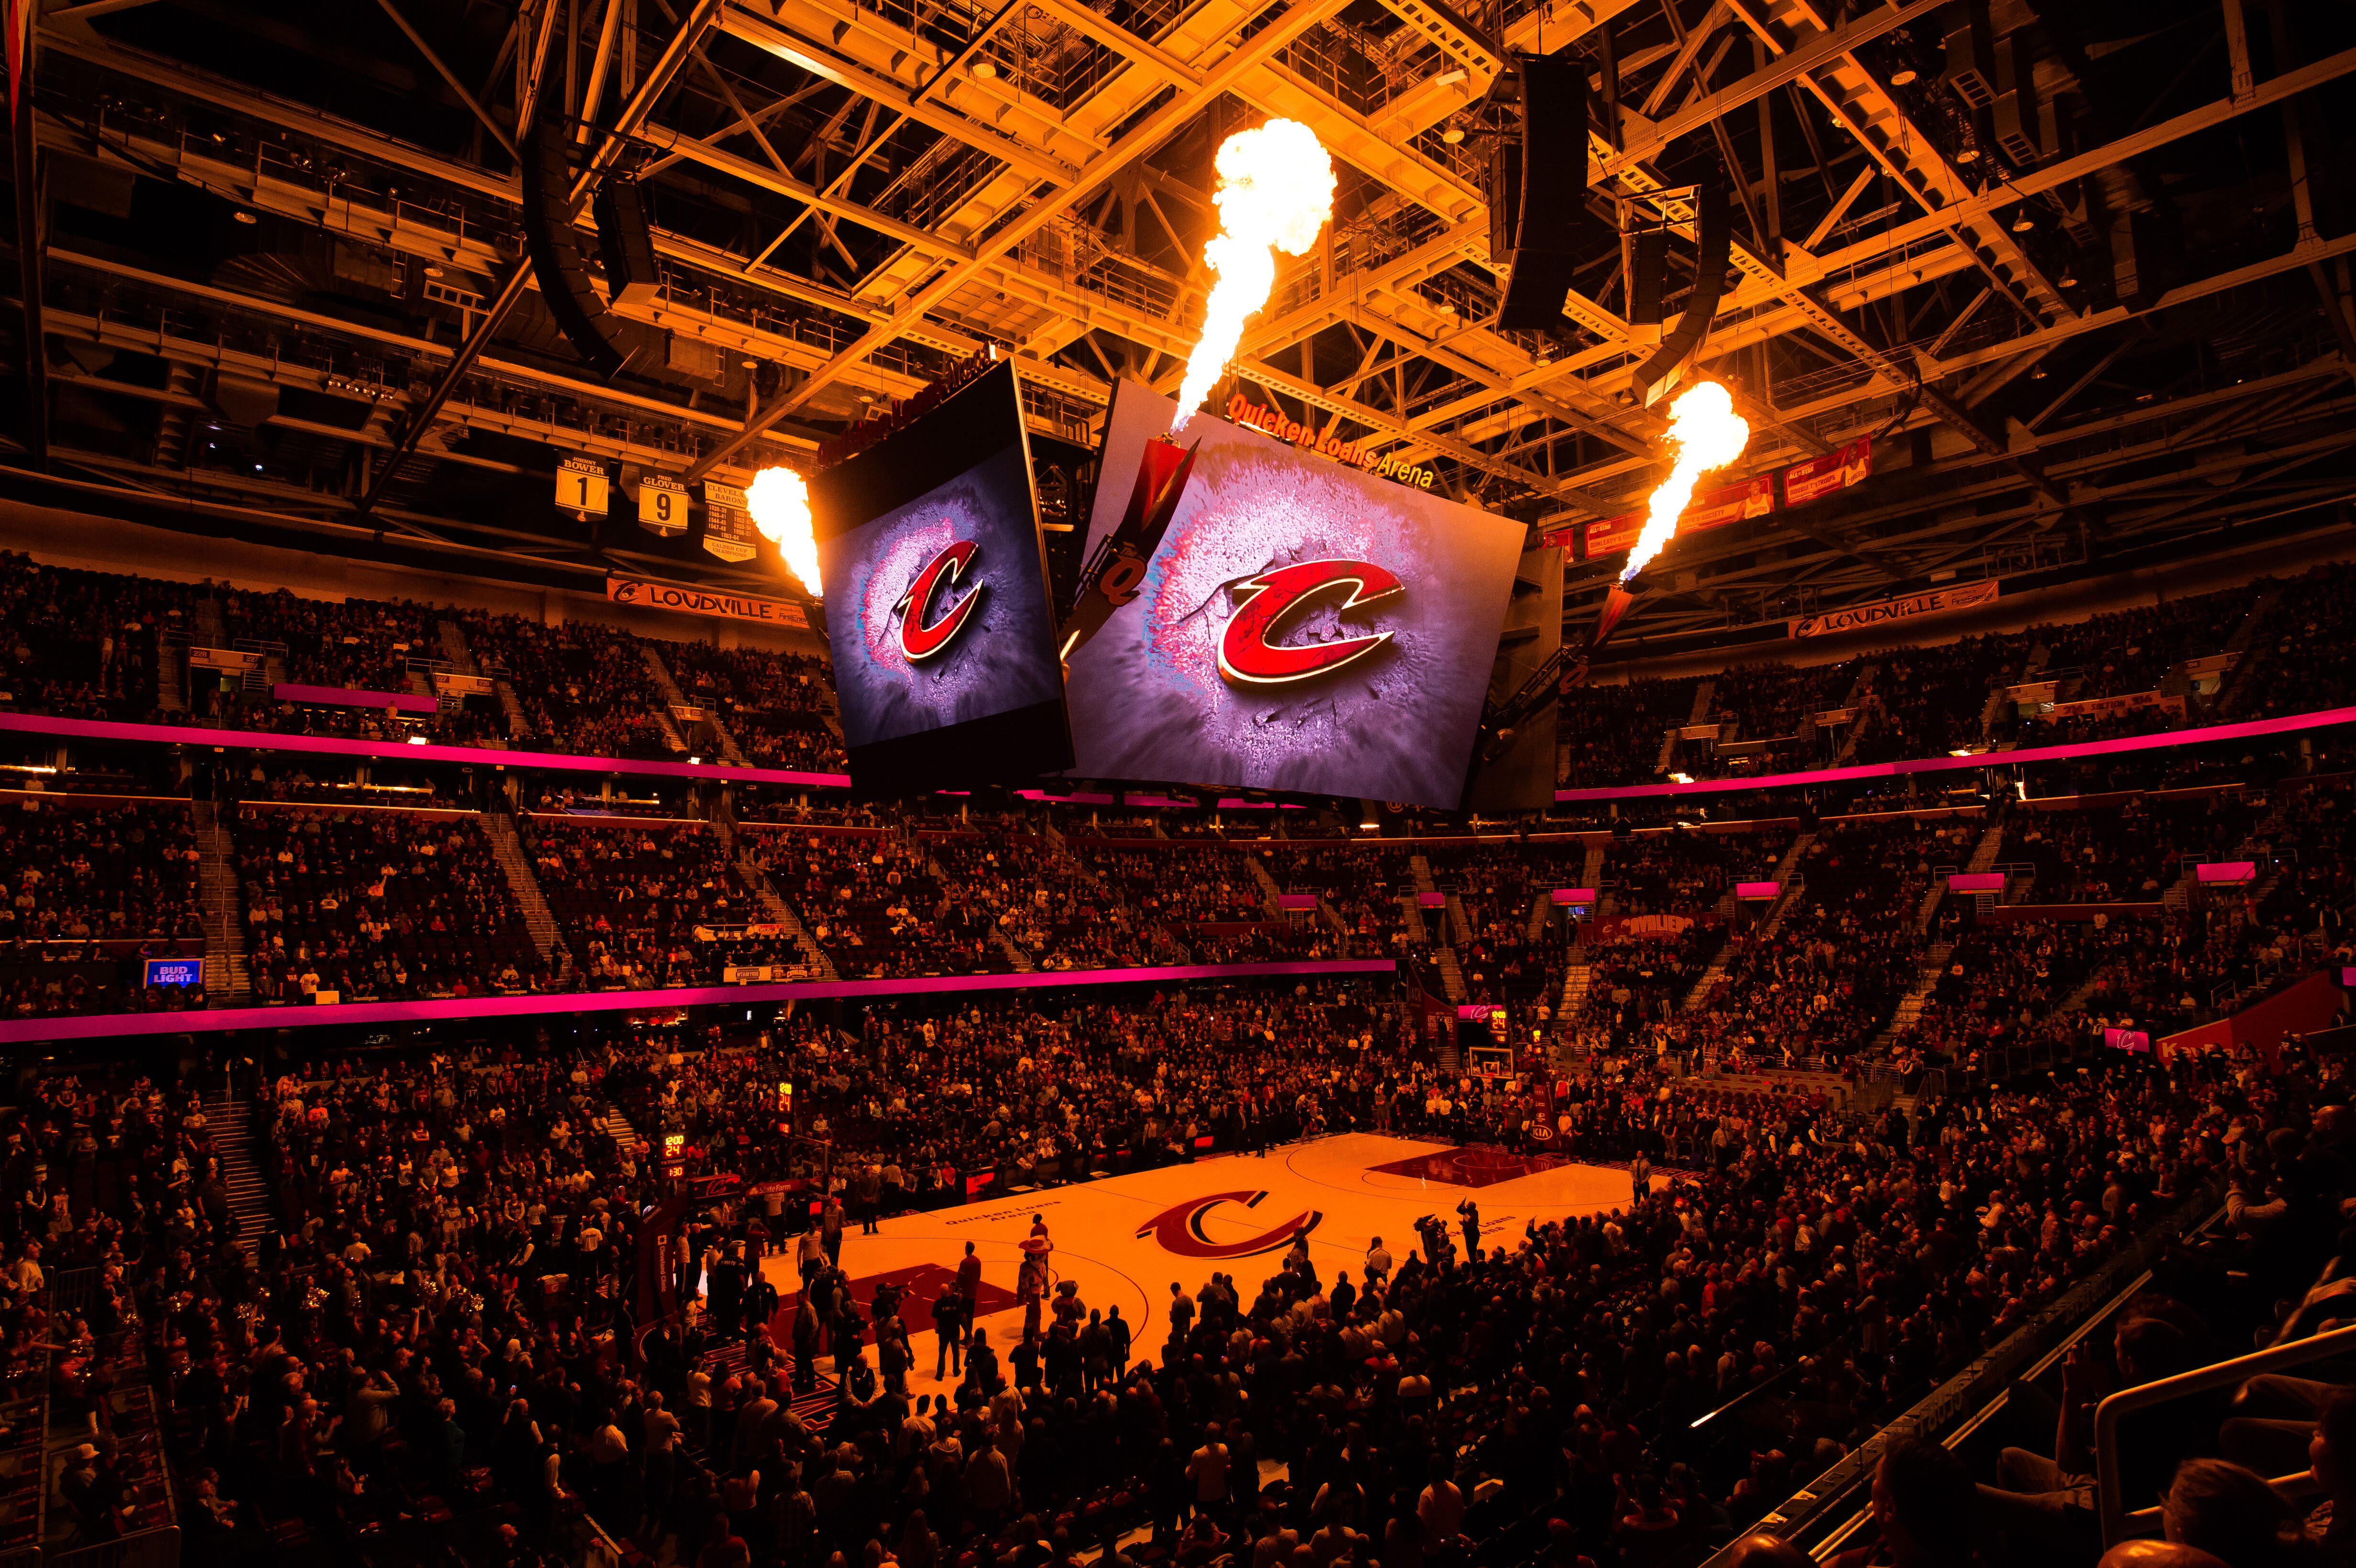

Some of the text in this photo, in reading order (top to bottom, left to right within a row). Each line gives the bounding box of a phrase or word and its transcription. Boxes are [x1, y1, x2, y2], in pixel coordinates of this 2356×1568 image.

[1228, 393, 1433, 488] Quicken Loans Arena
[573, 457, 596, 465] JOHNNY
[564, 459, 604, 475] BOWER
[643, 477, 685, 491] GLOVER
[1818, 475, 1835, 484] TROOPS
[577, 477, 587, 506] 1
[715, 493, 748, 506] BARONS
[657, 493, 671, 521] 9
[1702, 510, 1724, 520] SOCIETY
[1590, 536, 1621, 548] DUNLEAVY'S
[712, 547, 746, 558] CHAMPIONS
[650, 587, 773, 619] LOUDVILLE
[1824, 595, 1945, 631] LOUDVILLE
[159, 966, 188, 975] BUD
[153, 974, 193, 982] LIGHT
[1493, 1018, 1505, 1028] 24
[779, 1093, 790, 1111] 24
[1533, 1128, 1549, 1137] KIA
[666, 1135, 684, 1145] 12:00
[666, 1145, 679, 1156] 24
[670, 1167, 682, 1176] 1:30
[946, 1201, 1061, 1225] Quicken Loans
[991, 1210, 1036, 1222] Arena
[1477, 1216, 1516, 1227] Loans
